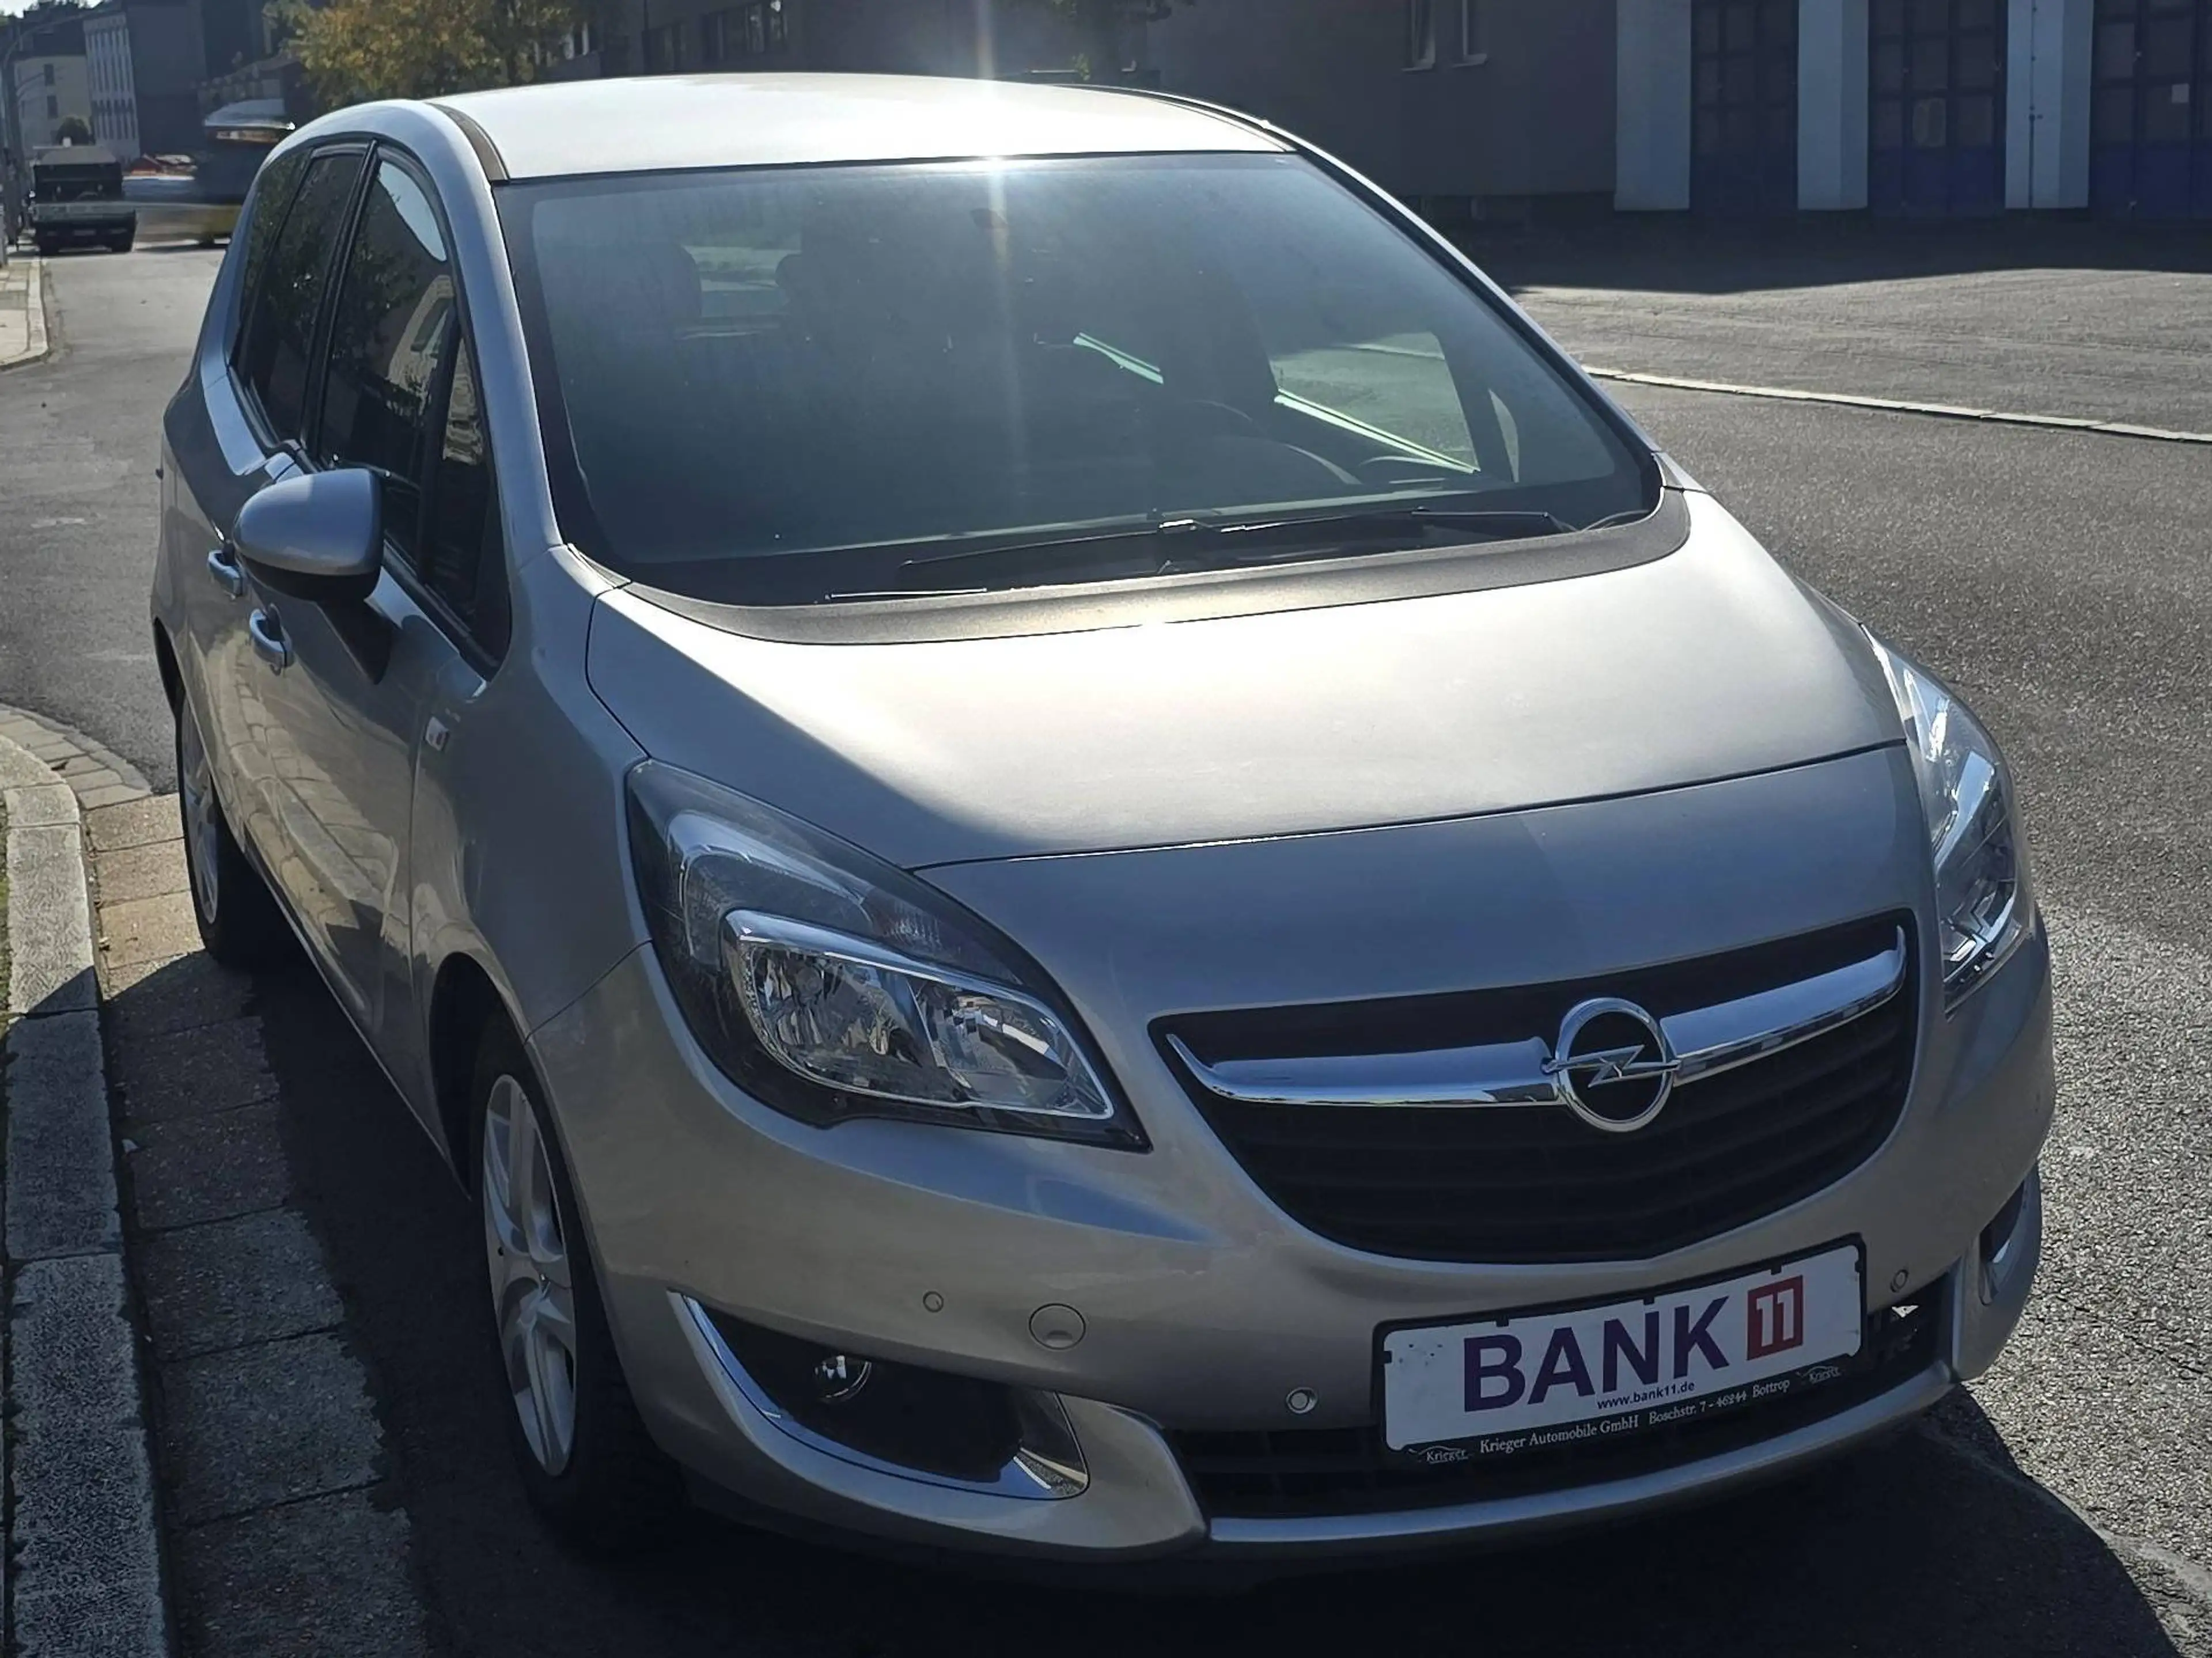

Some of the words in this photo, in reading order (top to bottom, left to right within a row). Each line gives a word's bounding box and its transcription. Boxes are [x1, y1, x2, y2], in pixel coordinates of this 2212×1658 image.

[1464, 1295, 1729, 1412] BANK
[1754, 1285, 1796, 1350] 11
[1479, 1436, 1527, 1454] Krieger
[1529, 1424, 1597, 1446] Automobile
[1600, 1414, 1639, 1434] GmbH
[1649, 1404, 1696, 1425] Boschstr.
[1699, 1401, 1706, 1412] 7
[1752, 1379, 1790, 1398] Bottrop
[1597, 1381, 1695, 1410] www.bank11.de
